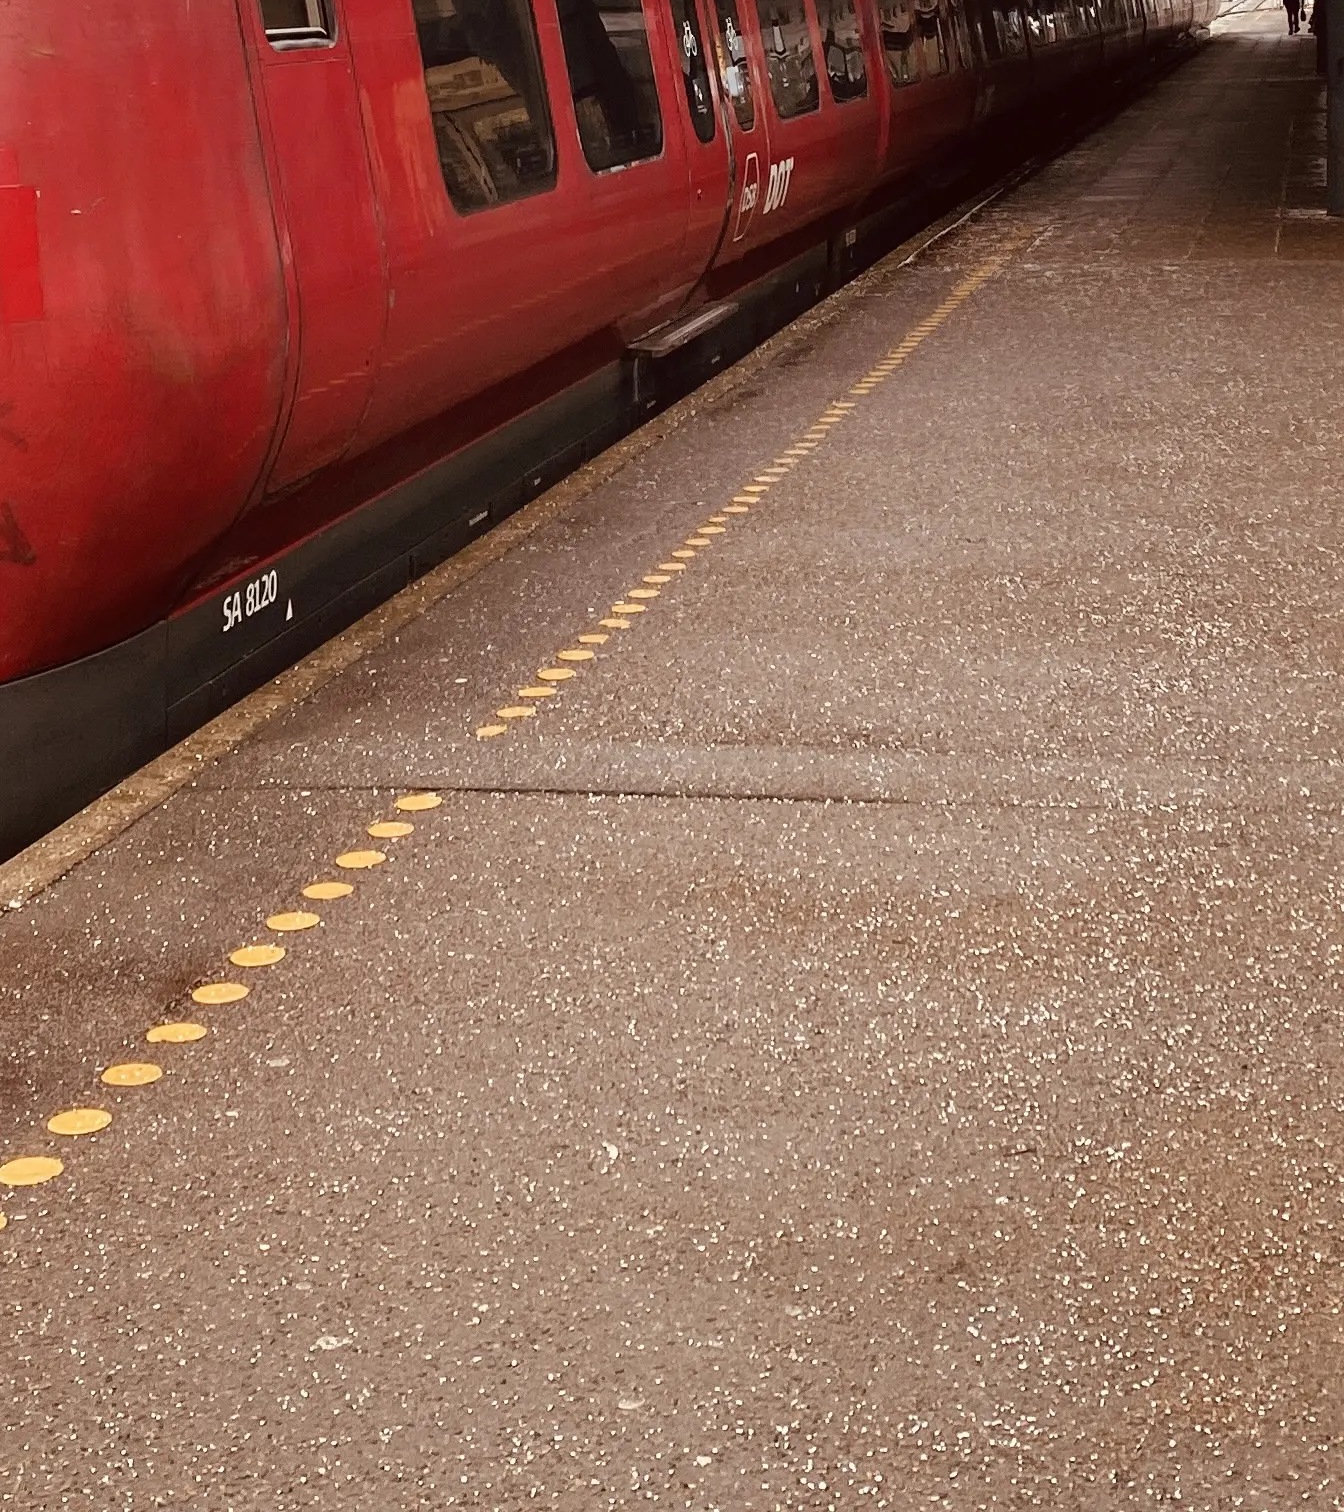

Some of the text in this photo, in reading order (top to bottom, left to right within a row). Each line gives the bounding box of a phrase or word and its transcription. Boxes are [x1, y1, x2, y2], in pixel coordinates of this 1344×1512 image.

[762, 156, 794, 214] DOT
[222, 569, 278, 632] SA 8120
